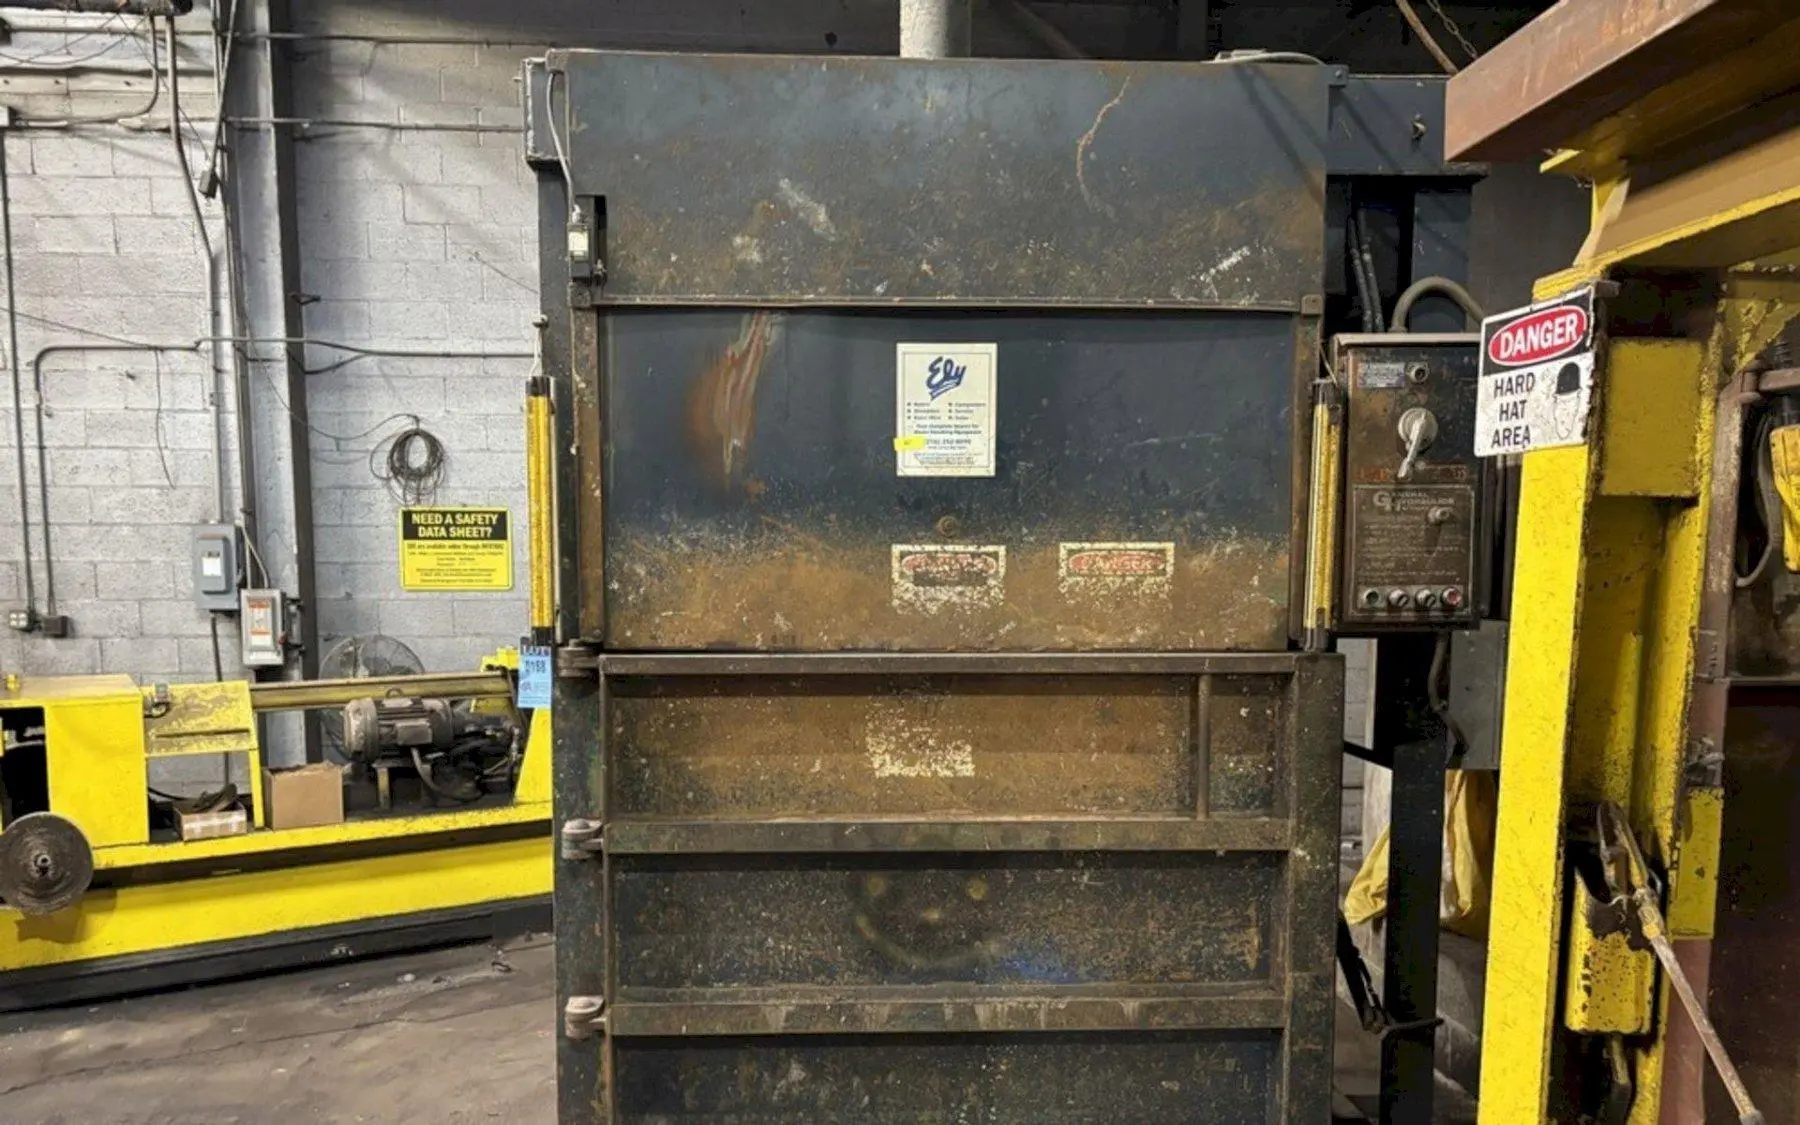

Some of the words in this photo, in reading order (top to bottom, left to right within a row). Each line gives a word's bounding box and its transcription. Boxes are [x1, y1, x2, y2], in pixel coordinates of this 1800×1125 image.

[1500, 313, 1579, 360] DANGER
[926, 356, 967, 400] Ely
[1494, 373, 1536, 399] HARD
[1499, 400, 1528, 422] HAT
[1491, 425, 1531, 449] AREA
[411, 513, 443, 525] NEED
[444, 513, 453, 525] A
[455, 513, 499, 525] SAFETY
[418, 526, 448, 538] DATA
[449, 526, 493, 538] SHEET?
